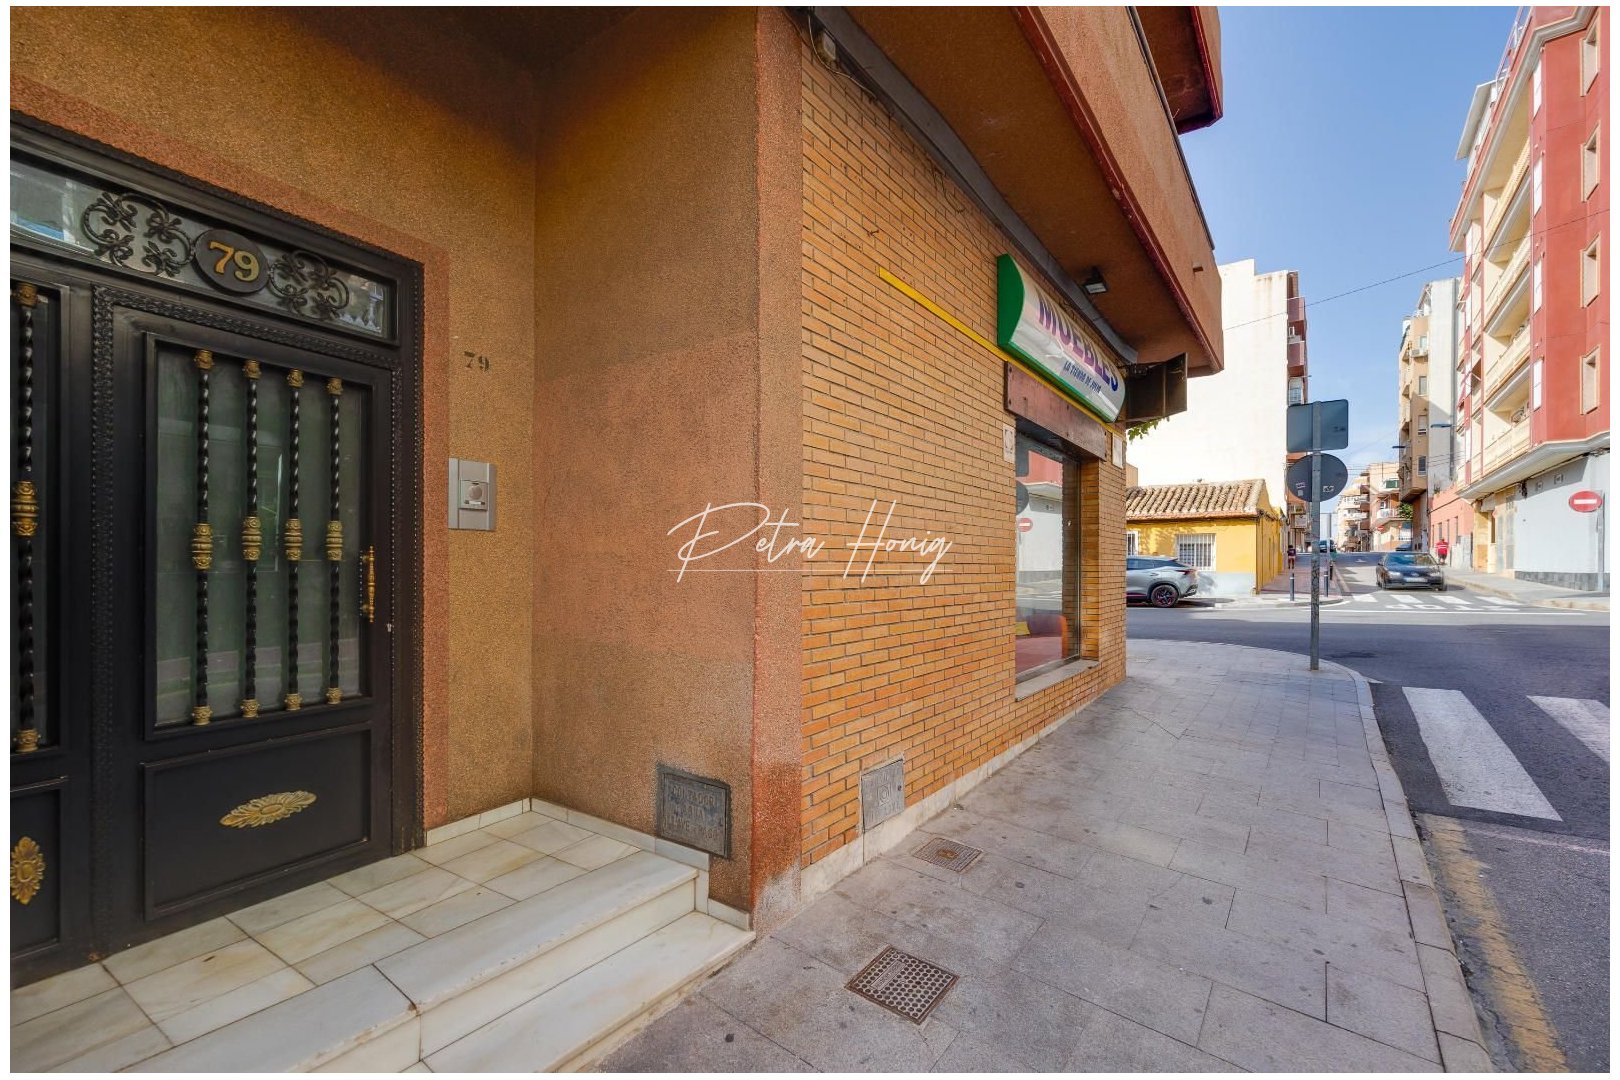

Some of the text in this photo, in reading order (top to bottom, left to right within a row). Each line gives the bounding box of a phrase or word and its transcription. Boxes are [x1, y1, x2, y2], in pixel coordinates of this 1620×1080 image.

[209, 241, 260, 282] 79
[1036, 288, 1119, 391] MUEBLES
[464, 350, 490, 372] 79
